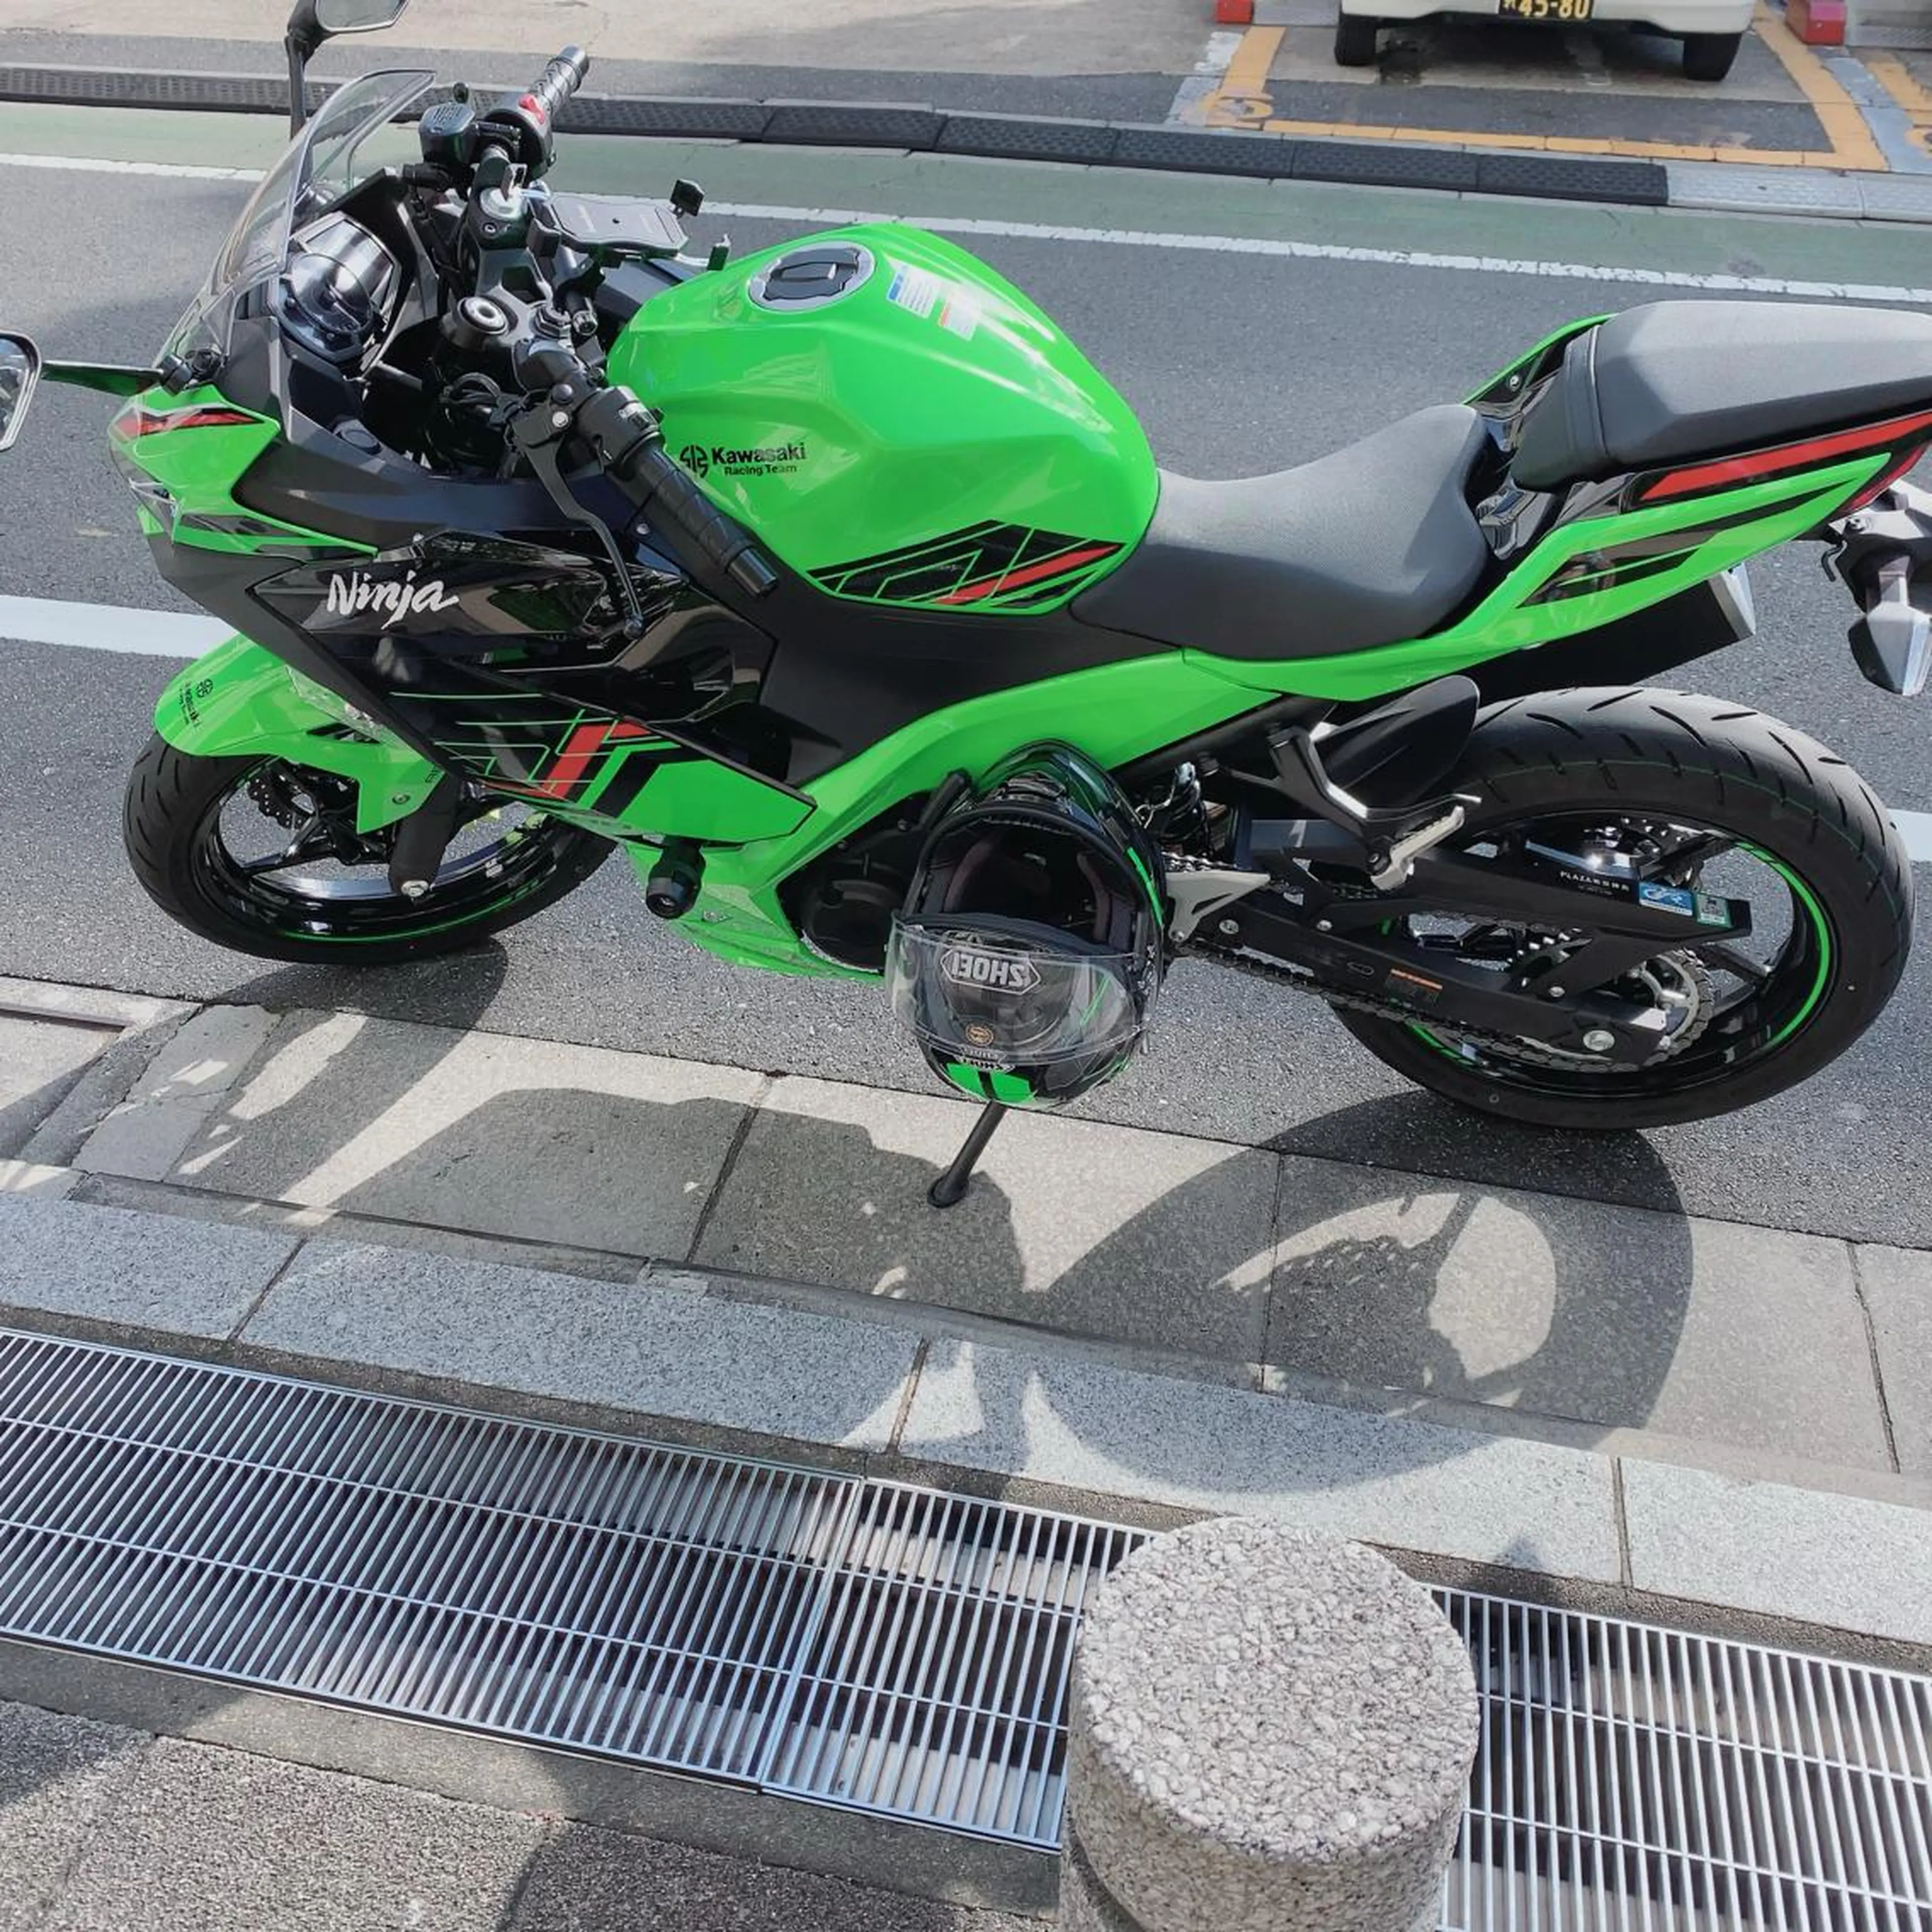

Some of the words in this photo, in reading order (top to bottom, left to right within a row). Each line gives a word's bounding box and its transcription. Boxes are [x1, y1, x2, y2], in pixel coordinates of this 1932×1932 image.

[1518, 0, 1589, 19] 45-80
[711, 442, 806, 465] Kawasaki
[725, 465, 763, 476] Racing
[765, 463, 797, 473] Team
[327, 570, 459, 630] Ninja
[951, 952, 1025, 987] SHOEI
